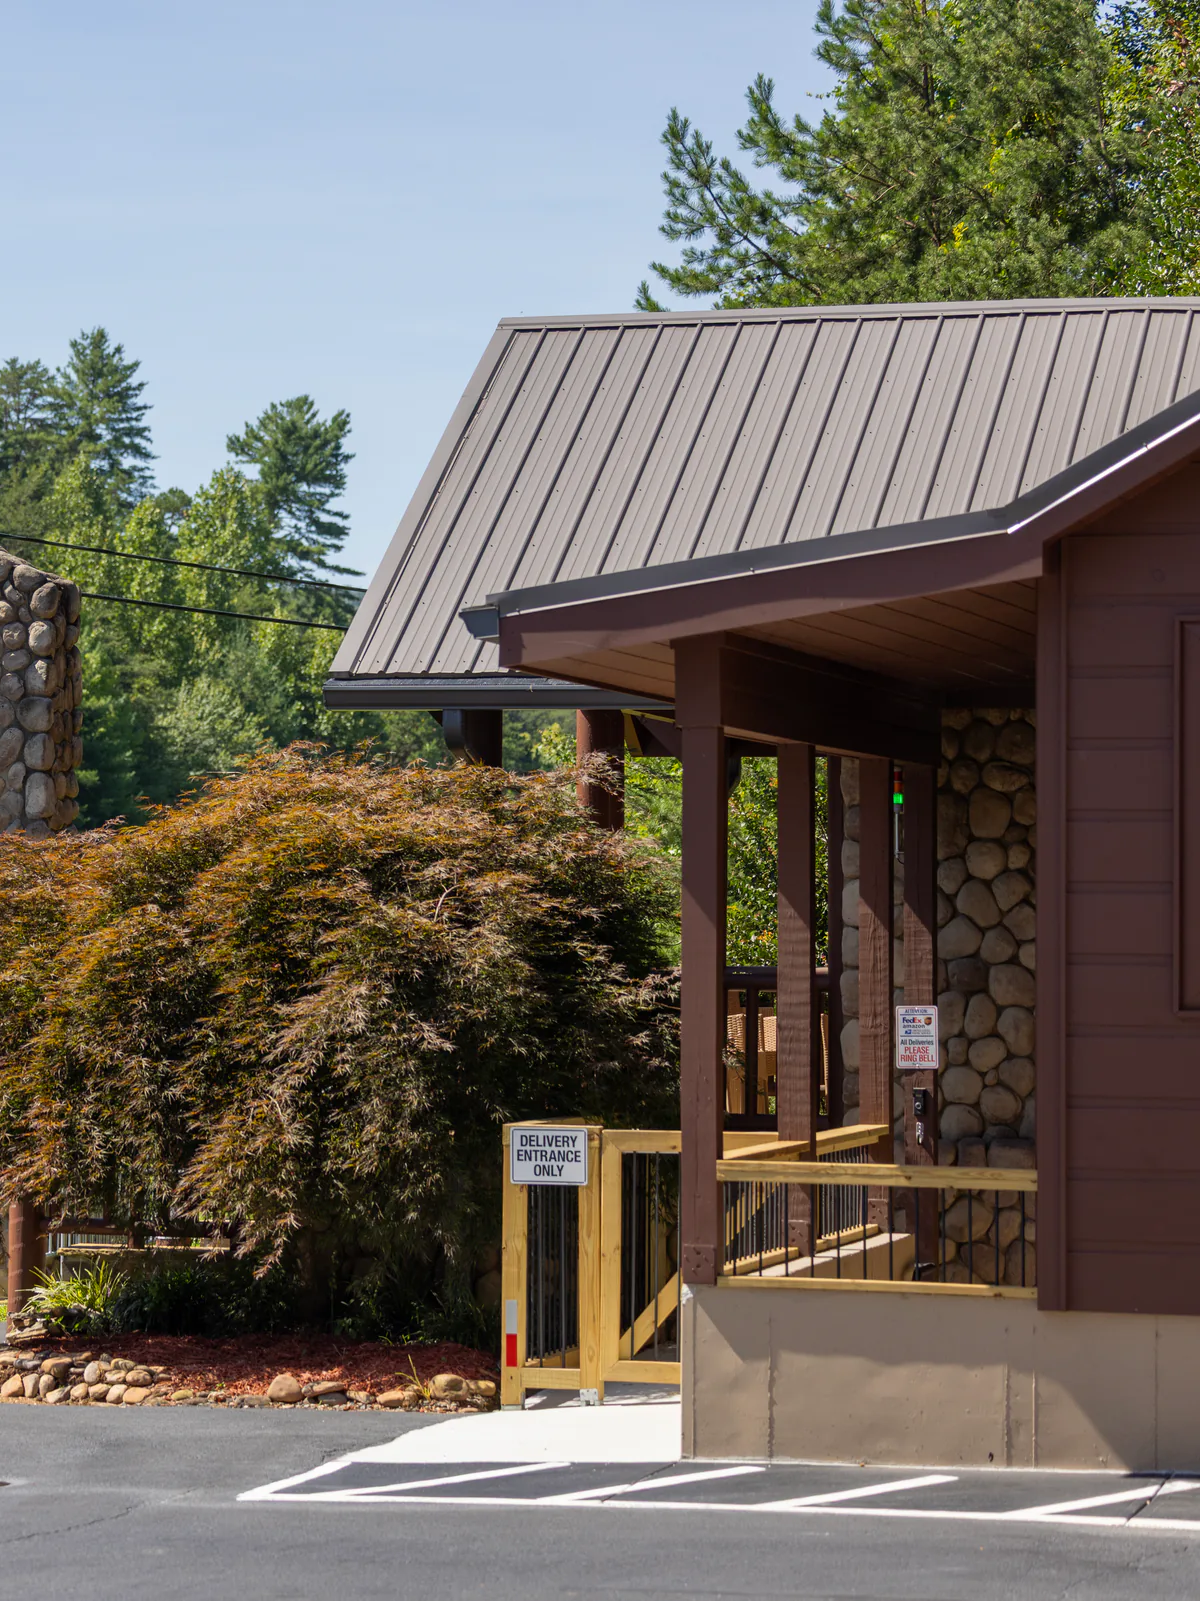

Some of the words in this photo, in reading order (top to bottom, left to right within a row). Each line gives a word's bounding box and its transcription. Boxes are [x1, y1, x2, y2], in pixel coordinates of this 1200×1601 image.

[904, 1046, 930, 1054] PLEASE
[900, 1054, 918, 1062] RING
[919, 1054, 935, 1062] BELL
[519, 1134, 578, 1148] DELIVERY
[516, 1149, 582, 1163] ENTRANCE
[533, 1164, 565, 1177] ONLY
